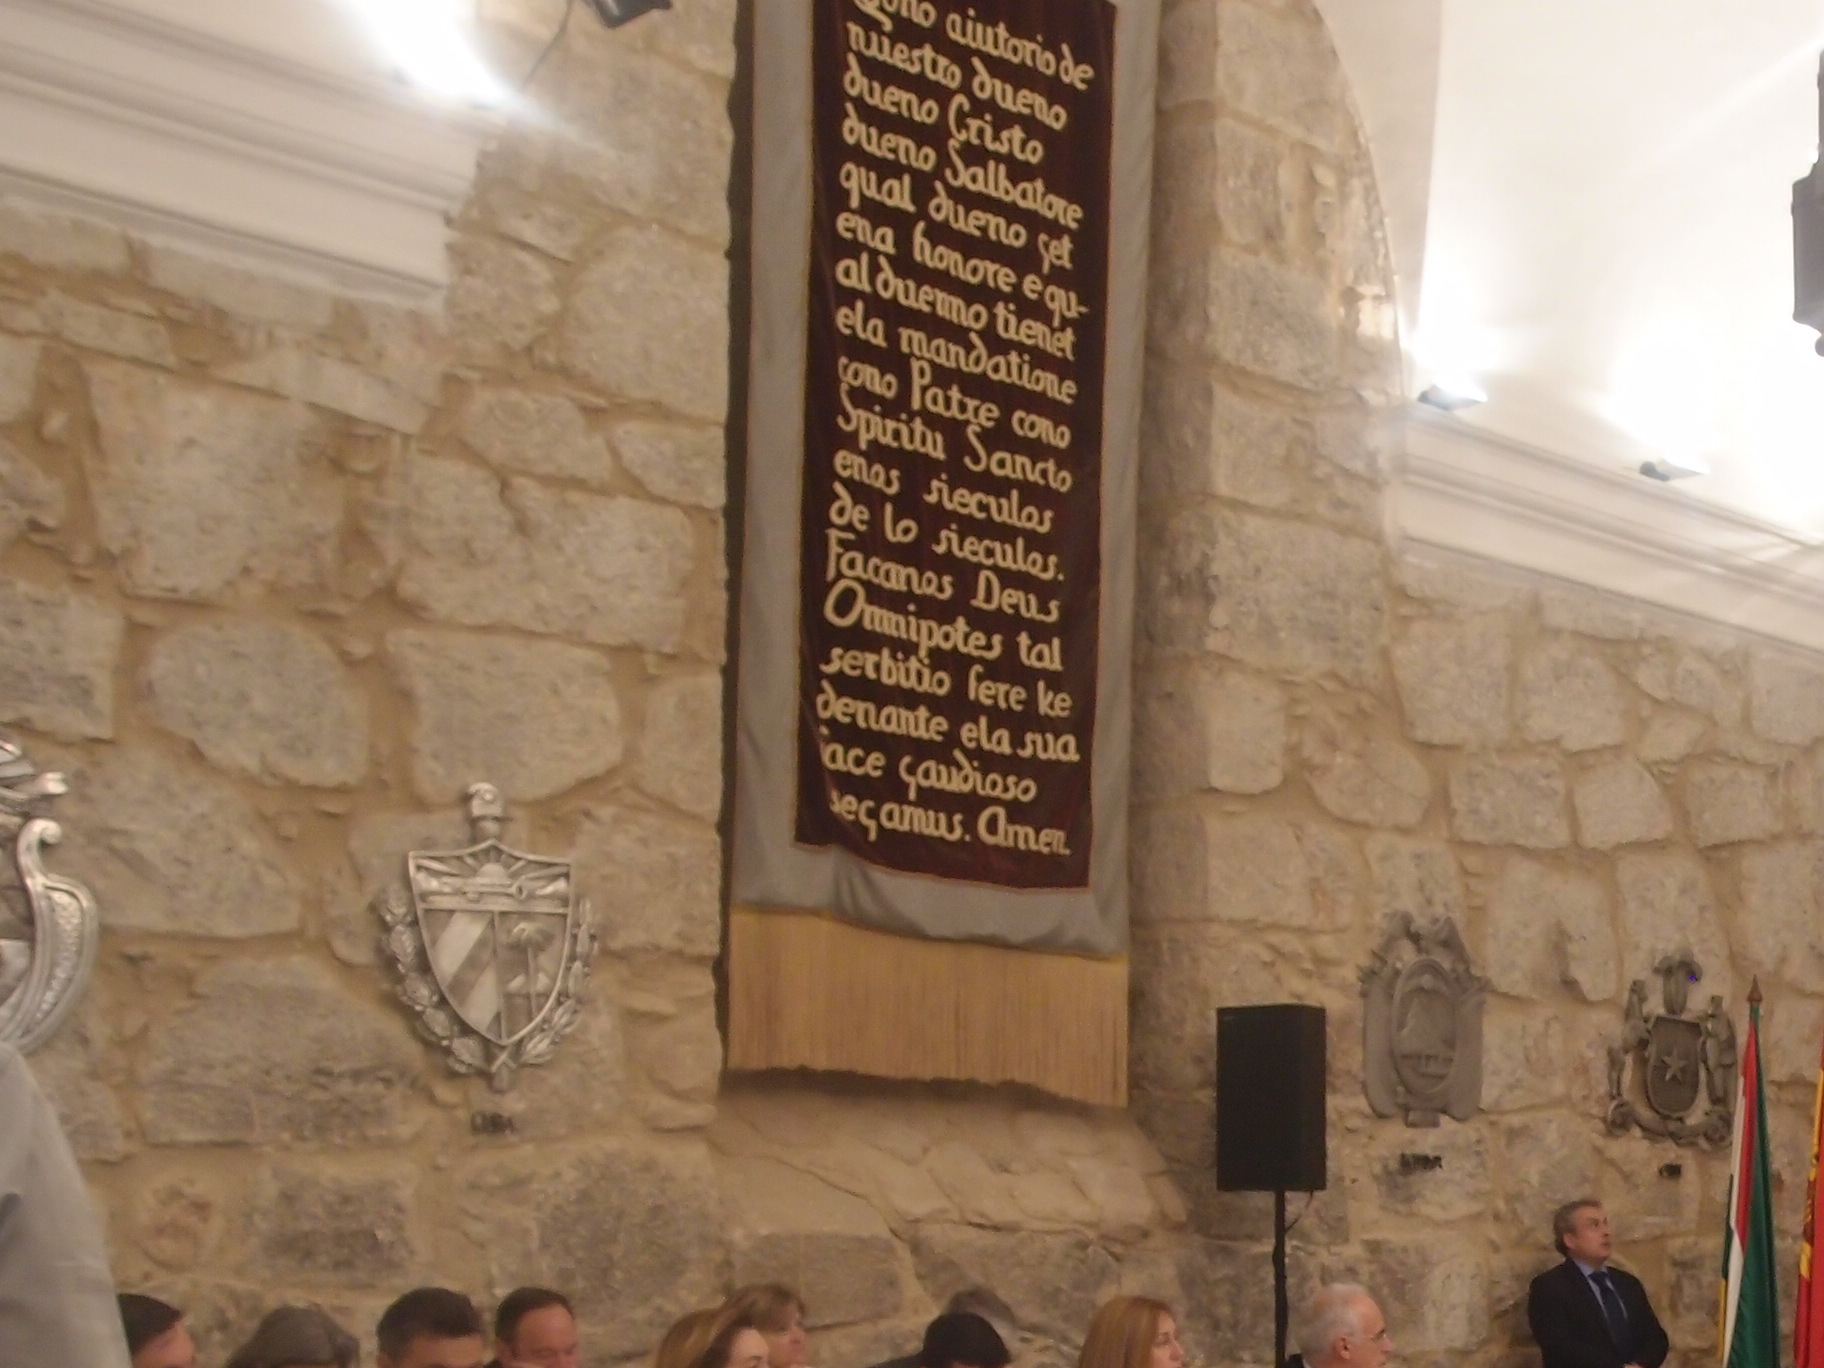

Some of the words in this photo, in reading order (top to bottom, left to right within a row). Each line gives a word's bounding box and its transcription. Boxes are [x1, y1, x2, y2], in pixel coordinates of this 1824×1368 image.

[844, 53, 940, 124] dueno
[949, 93, 1044, 164] Cristo
[846, 21, 962, 90] nuestro
[971, 56, 1067, 131] dueno
[1059, 43, 1095, 90] de
[839, 162, 917, 213] qual
[928, 180, 1027, 248] dueno
[842, 102, 937, 172] dueno
[945, 138, 1084, 230] Salbatore
[836, 211, 897, 255] ena
[912, 220, 1017, 293] honore
[1022, 274, 1043, 300] e
[835, 252, 873, 295] al
[993, 301, 1076, 361] tienet
[835, 299, 888, 348] ela
[898, 327, 1078, 405] mandatione
[836, 382, 947, 461] Spiritu
[963, 424, 1073, 494] Sancto
[837, 355, 898, 399] cono
[910, 356, 1000, 429] Patre
[1011, 408, 1072, 450] cono
[829, 480, 871, 532] de
[884, 502, 918, 544] lo
[931, 523, 1065, 582] sieculos.
[833, 448, 901, 495] enos
[922, 473, 1054, 534] sieculos
[824, 527, 955, 600] Facanos
[970, 569, 1061, 624] Deus
[823, 578, 1003, 660] Omnipotes
[1016, 630, 1064, 672] tal
[815, 679, 949, 743] denante
[959, 715, 1013, 756] ela
[1016, 732, 1081, 763] sua
[819, 646, 951, 697] serbitio
[1037, 679, 1074, 718] ke
